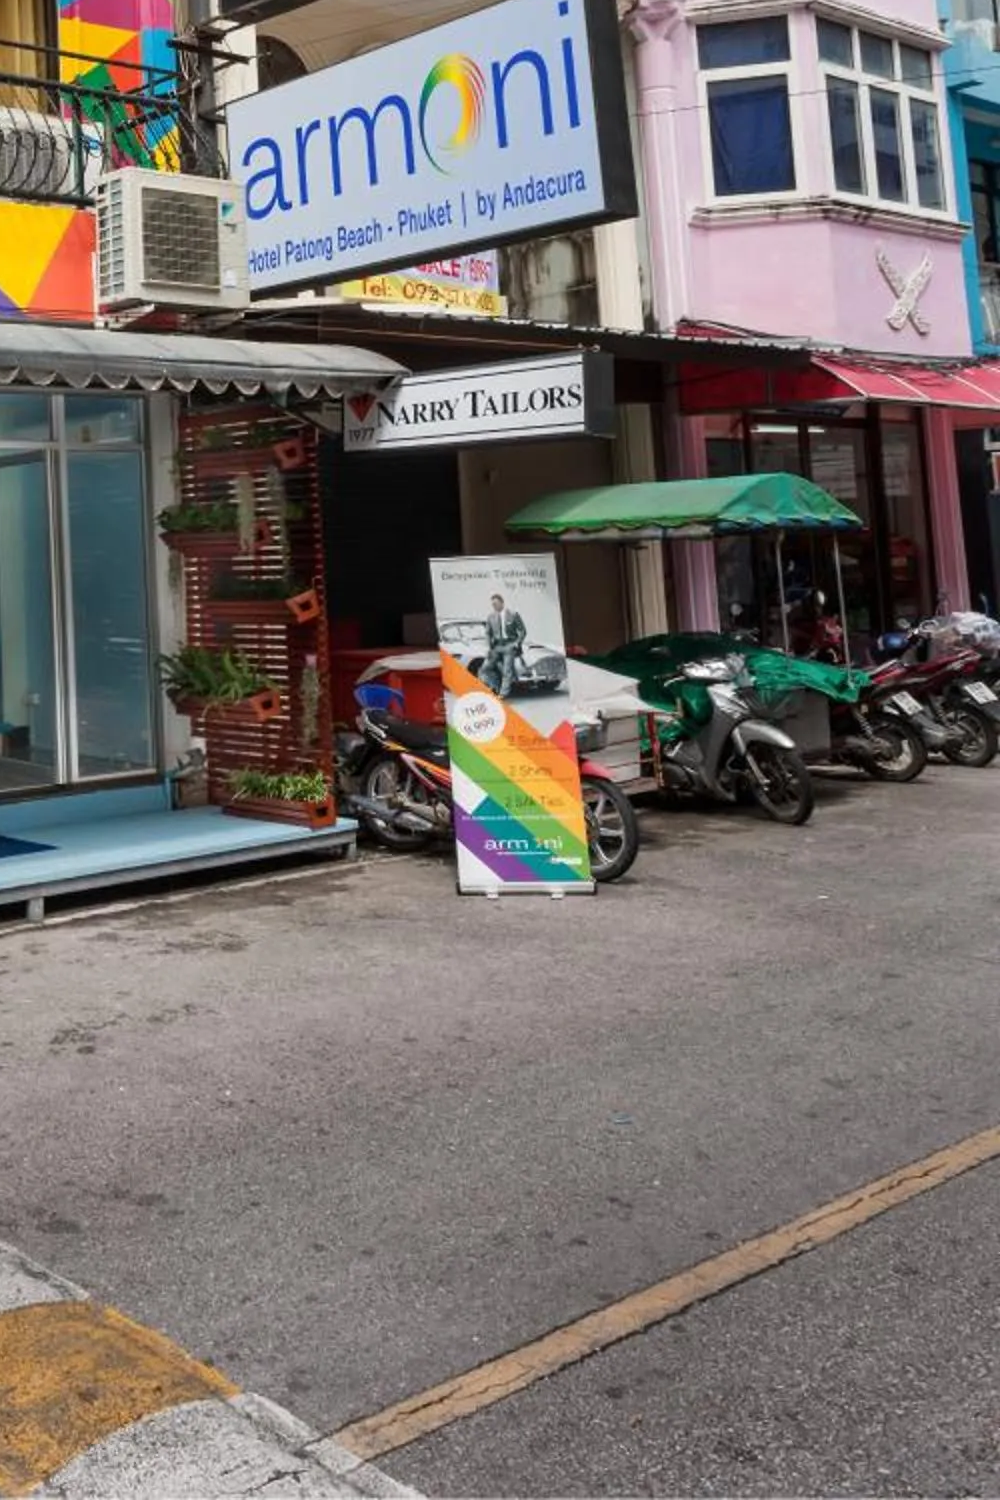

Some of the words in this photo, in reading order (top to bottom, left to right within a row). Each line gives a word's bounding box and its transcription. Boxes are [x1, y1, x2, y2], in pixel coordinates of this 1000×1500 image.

[242, 0, 581, 221] armoni
[249, 244, 281, 274] Hotel
[285, 235, 333, 266] Patong
[337, 218, 383, 251] Beach
[398, 200, 452, 236] Phuket
[476, 189, 497, 221] by
[503, 169, 587, 210] Andacura
[348, 427, 375, 443] 1977
[376, 398, 460, 428] NARRY
[464, 384, 582, 419] TAILORS
